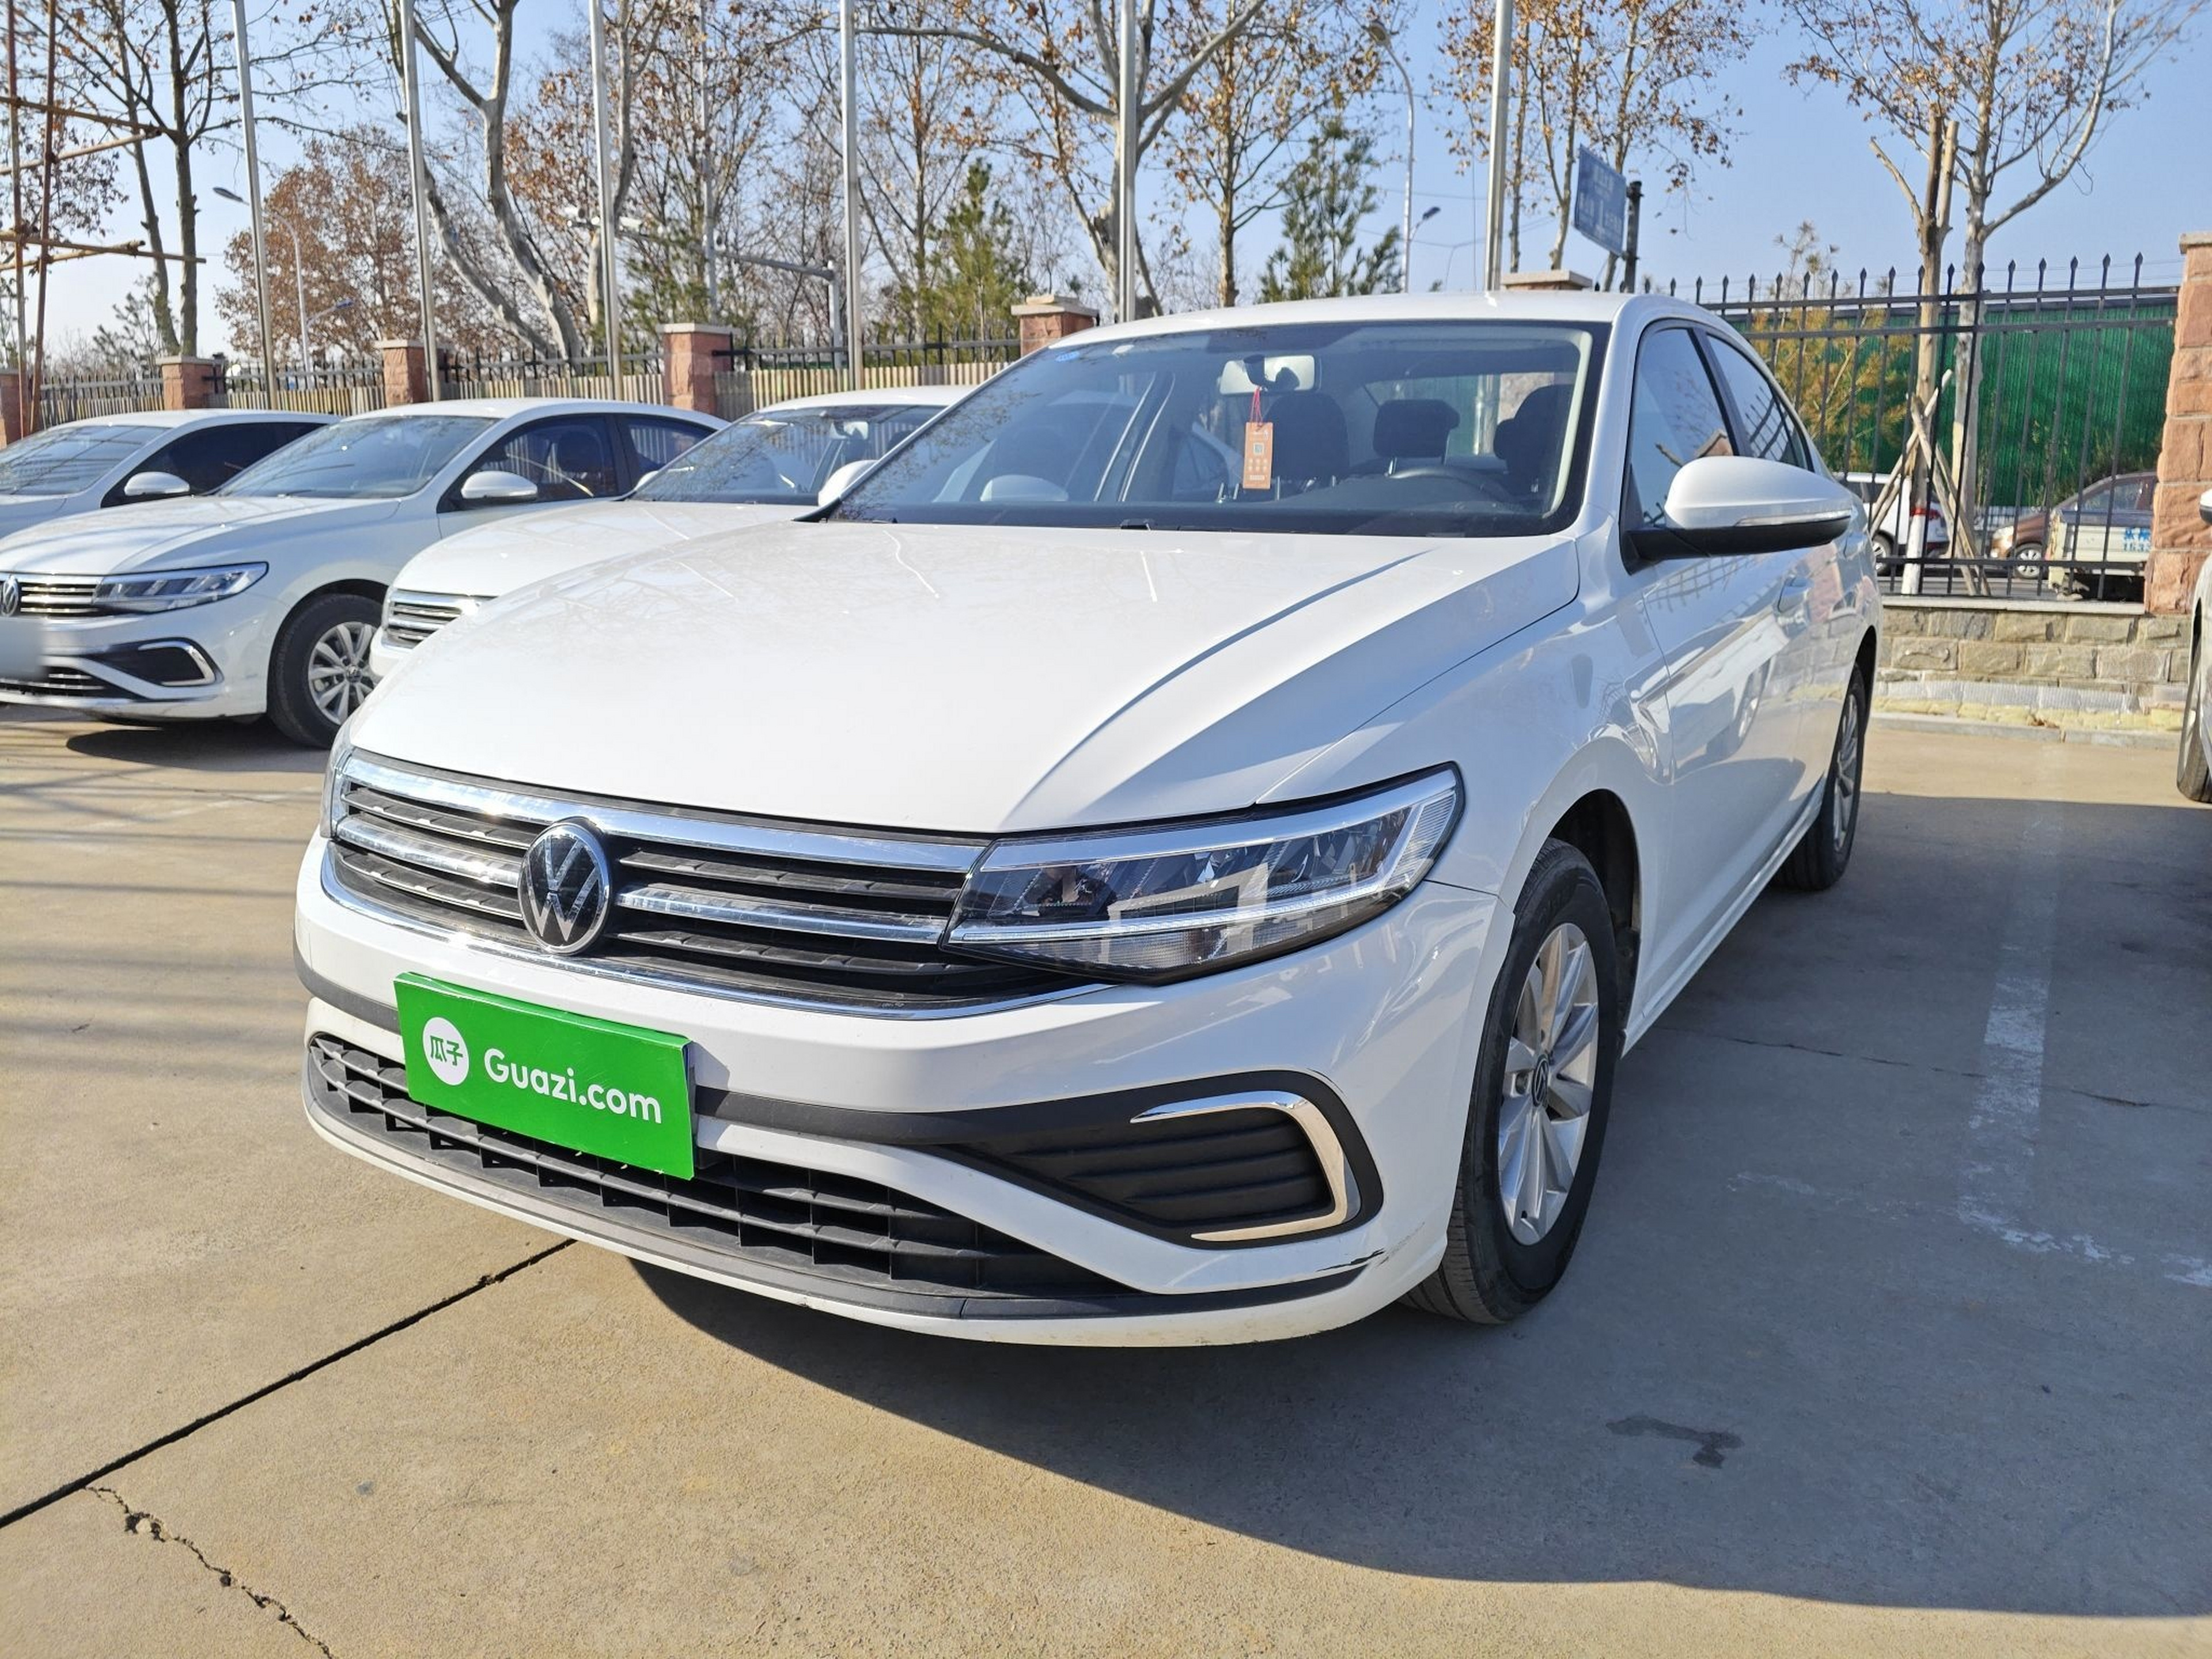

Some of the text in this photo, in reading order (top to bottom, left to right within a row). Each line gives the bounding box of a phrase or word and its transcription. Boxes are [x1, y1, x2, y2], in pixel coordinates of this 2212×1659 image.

[522, 830, 605, 946] VW
[430, 1035, 463, 1066] 瓜子
[484, 1048, 661, 1123] Guazi.com
